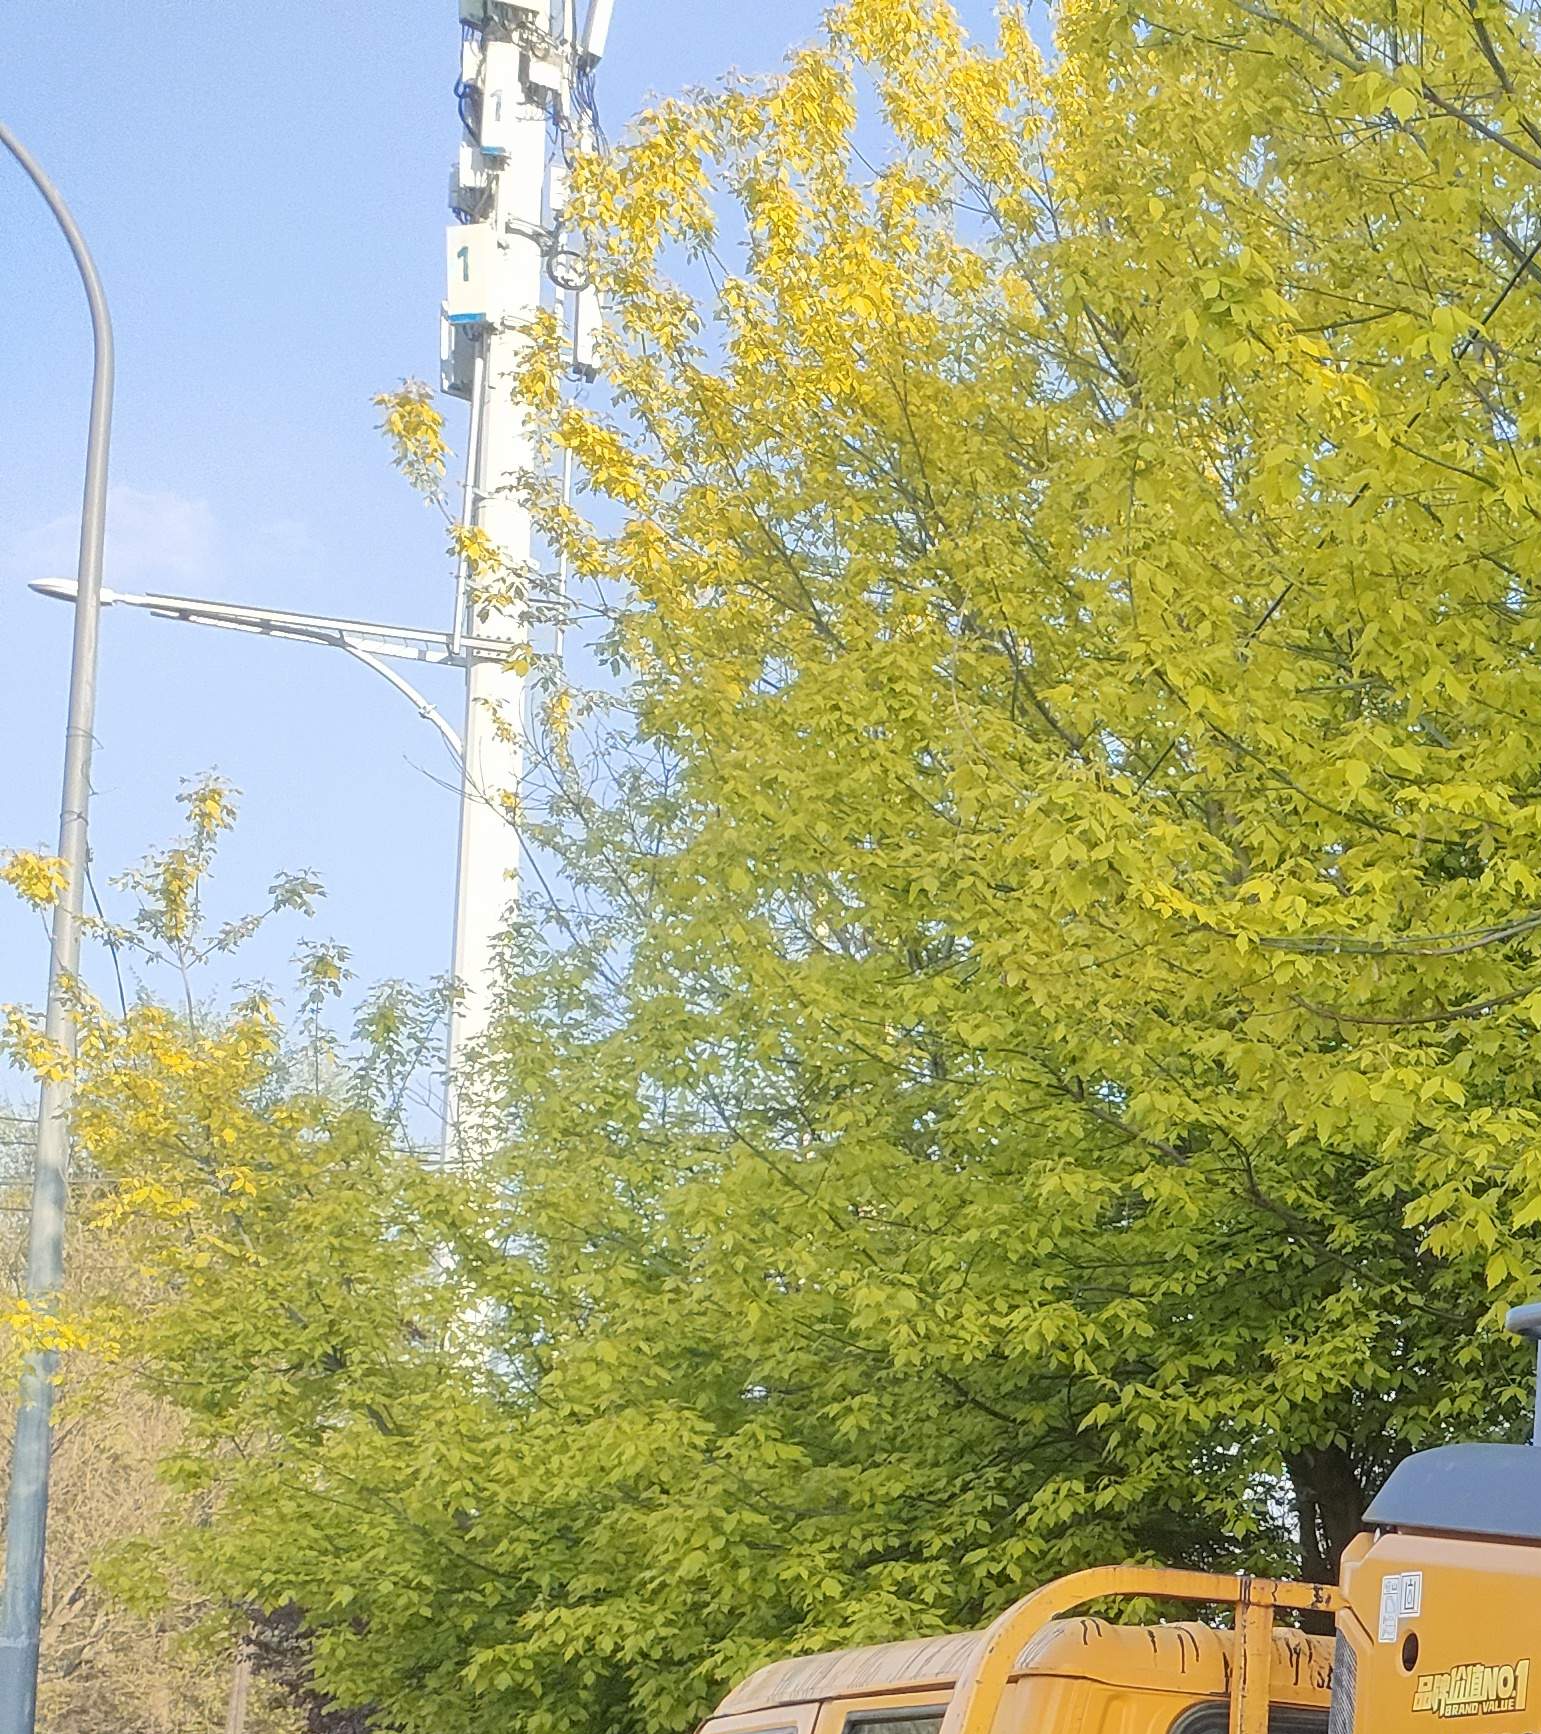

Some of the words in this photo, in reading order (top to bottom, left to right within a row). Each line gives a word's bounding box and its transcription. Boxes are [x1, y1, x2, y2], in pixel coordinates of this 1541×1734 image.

[456, 245, 470, 281] 1
[1444, 1702, 1479, 1717] BRAND
[1482, 1699, 1515, 1714] VALUE
